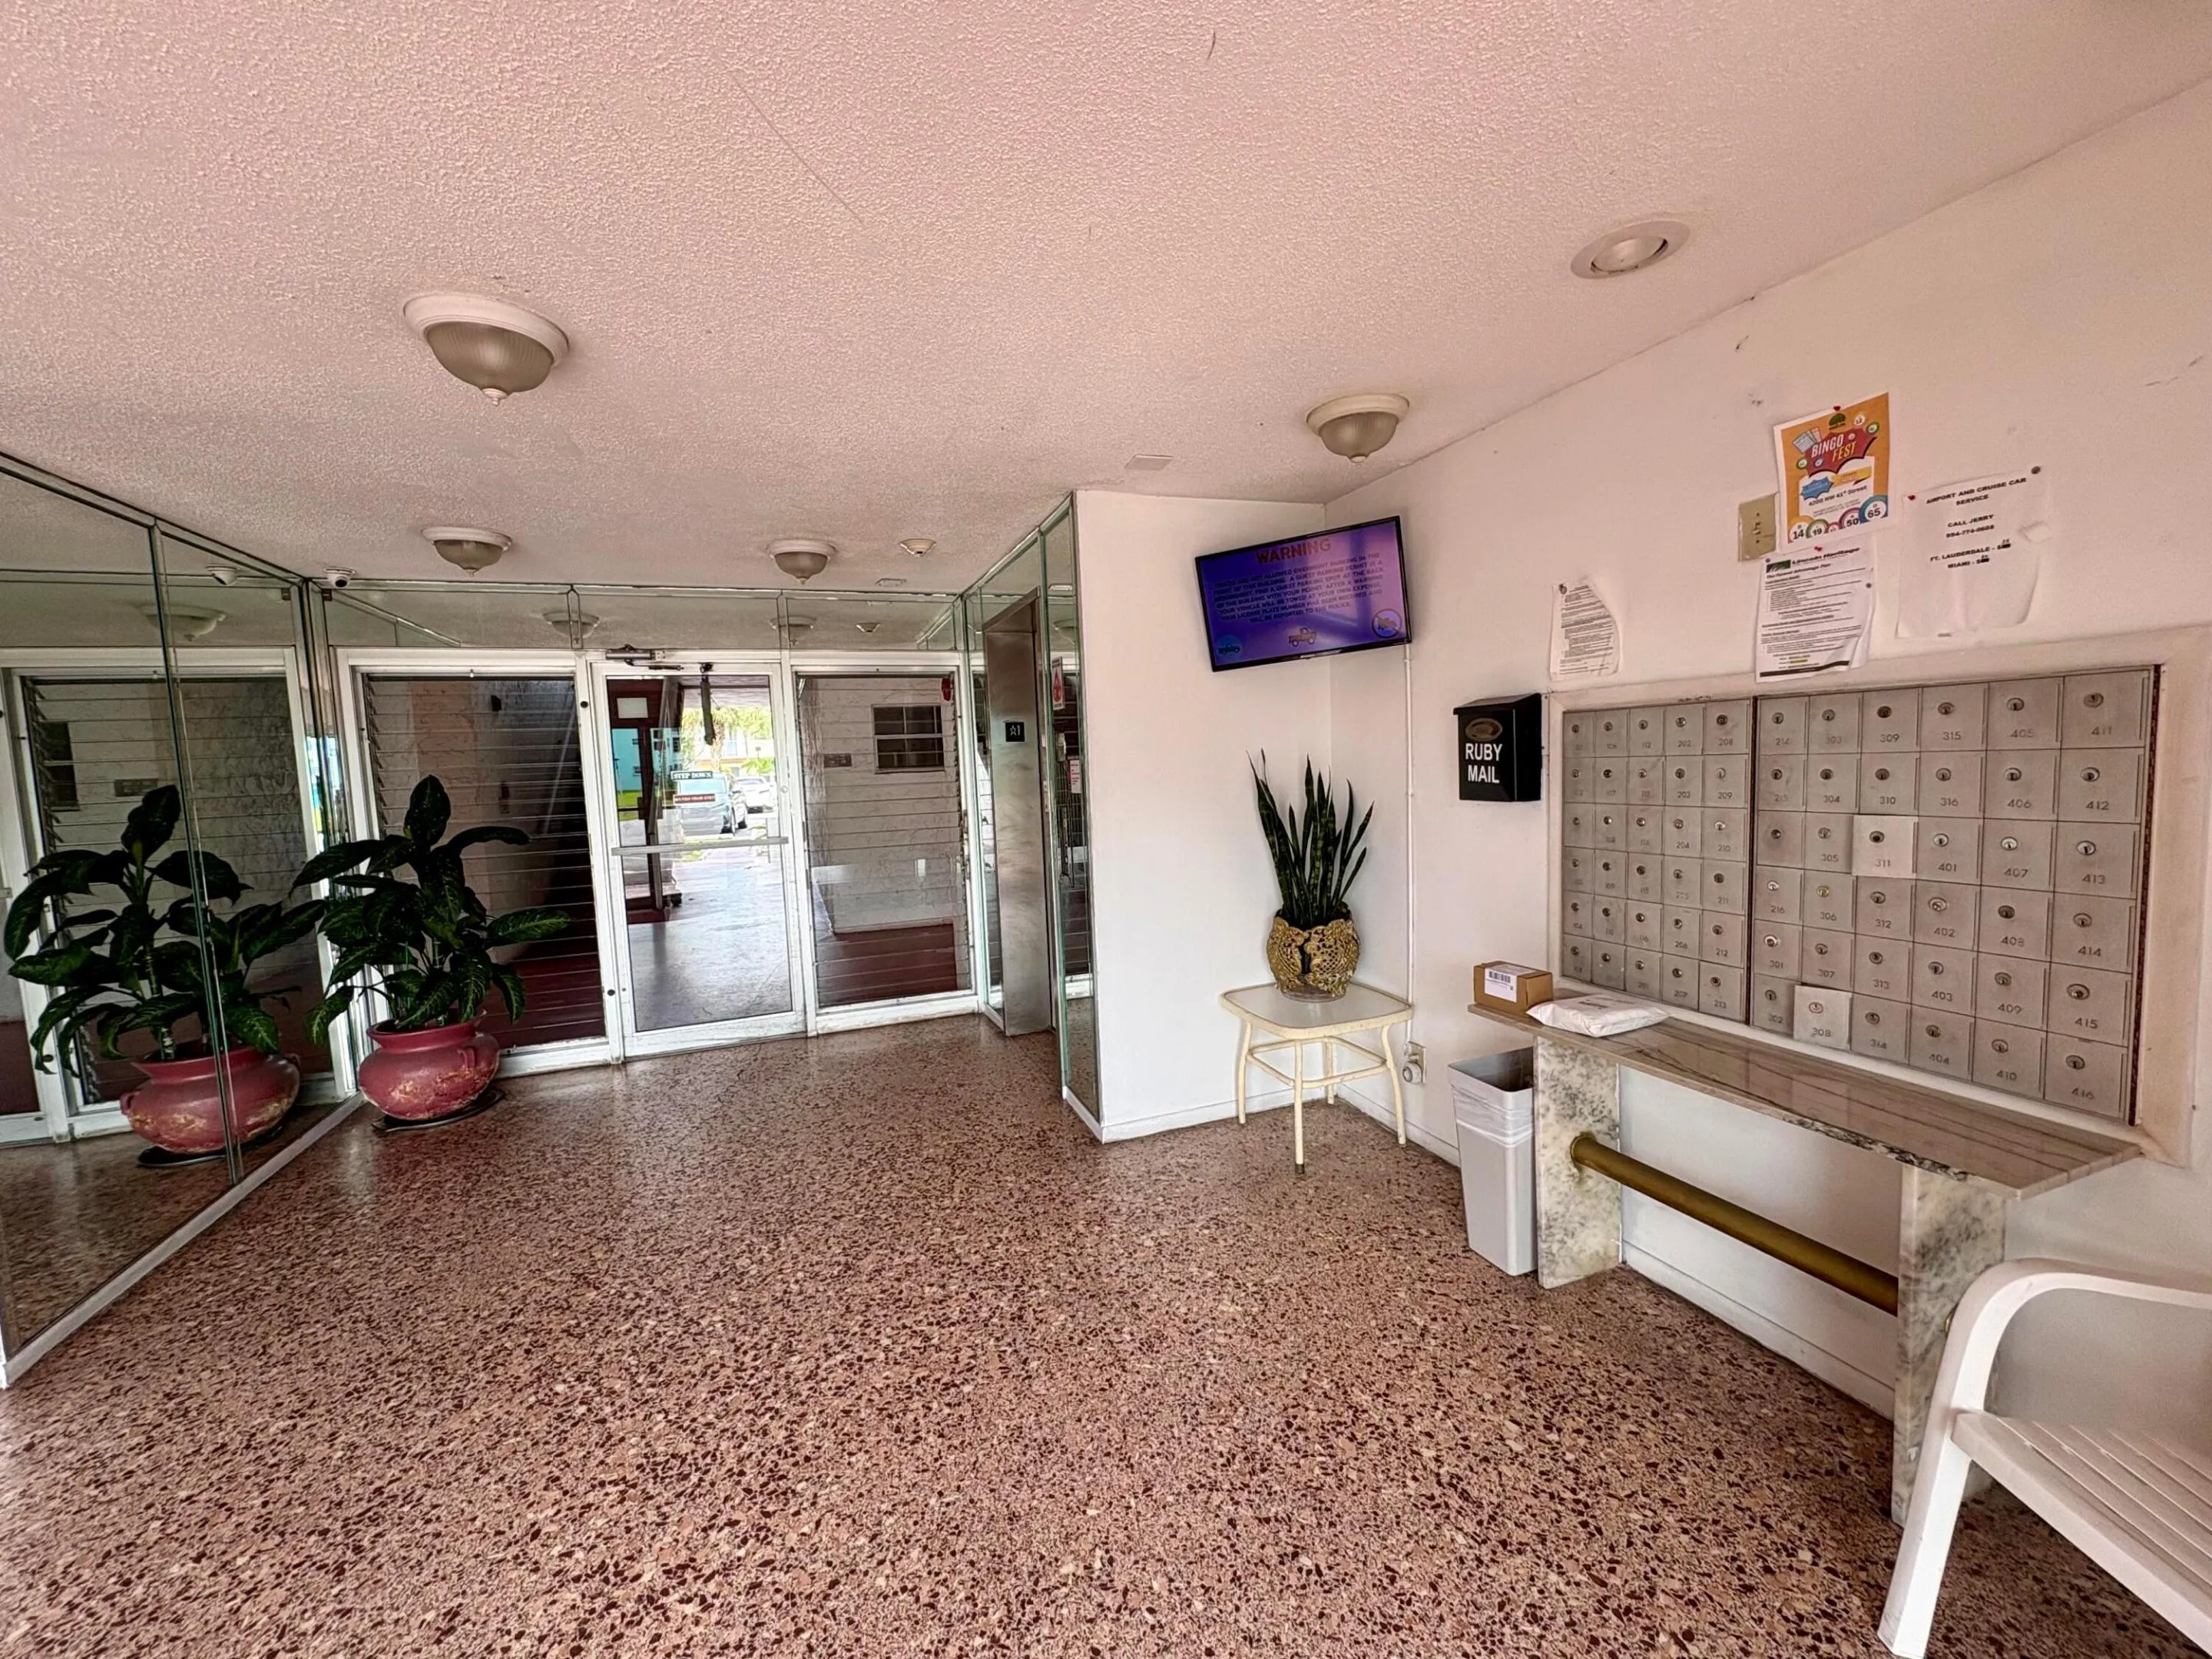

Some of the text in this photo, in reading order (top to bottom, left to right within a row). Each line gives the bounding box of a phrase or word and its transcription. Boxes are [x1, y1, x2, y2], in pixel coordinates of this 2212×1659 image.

[1811, 434, 1844, 459] BINGO
[1832, 441, 1856, 462] FEST
[1848, 485, 1867, 495] Street
[1926, 492, 1956, 504] AIRPORT
[1976, 482, 2007, 492] CRUISE
[2008, 477, 2027, 485] CAR
[1956, 494, 1989, 505] SERVICE
[1867, 507, 1881, 518] 65
[1846, 518, 1859, 527] 50
[1969, 514, 1995, 524] JERRY
[1793, 529, 1804, 540] 14
[1813, 528, 1823, 536] 19
[1257, 538, 1331, 564] WARNING
[1942, 546, 1990, 559] LAUDERDALE
[1942, 731, 1962, 740] 315
[2010, 729, 2035, 738] 405
[2091, 727, 2112, 736] 411
[1718, 738, 1734, 747] 208
[1880, 734, 1900, 743] 309
[1465, 743, 1503, 761] RUBY
[1468, 764, 1500, 783] MAIL
[1879, 796, 1896, 805] 310
[1940, 798, 1959, 806] 316
[2008, 799, 2032, 808] 406
[2085, 801, 2110, 810] 412
[1677, 841, 1690, 849] 204
[1821, 854, 1839, 863] 305
[1875, 859, 1891, 868] 311
[1938, 863, 1957, 873] 401
[2004, 868, 2028, 878] 407
[2082, 874, 2106, 884] 413
[1770, 906, 1785, 914] 216
[1820, 912, 1837, 921] 306
[1876, 919, 1892, 929] 312
[1933, 927, 1956, 938] 402
[1675, 941, 1688, 949] 206
[2000, 936, 2025, 947] 408
[1716, 949, 1729, 958] 212
[2078, 946, 2102, 957] 414
[1770, 960, 1783, 969] 301
[1818, 969, 1836, 979] 307
[1873, 979, 1889, 990] 313
[1931, 991, 1953, 1002] 403
[1998, 1004, 2022, 1015] 409
[1768, 1015, 1783, 1024] 302
[2075, 1018, 2098, 1029] 415
[1812, 1028, 1831, 1038] 308
[1870, 1039, 1887, 1050] 314
[1929, 1054, 1950, 1065] 404
[1996, 1070, 2018, 1081] 410
[2071, 1088, 2094, 1100] 416
